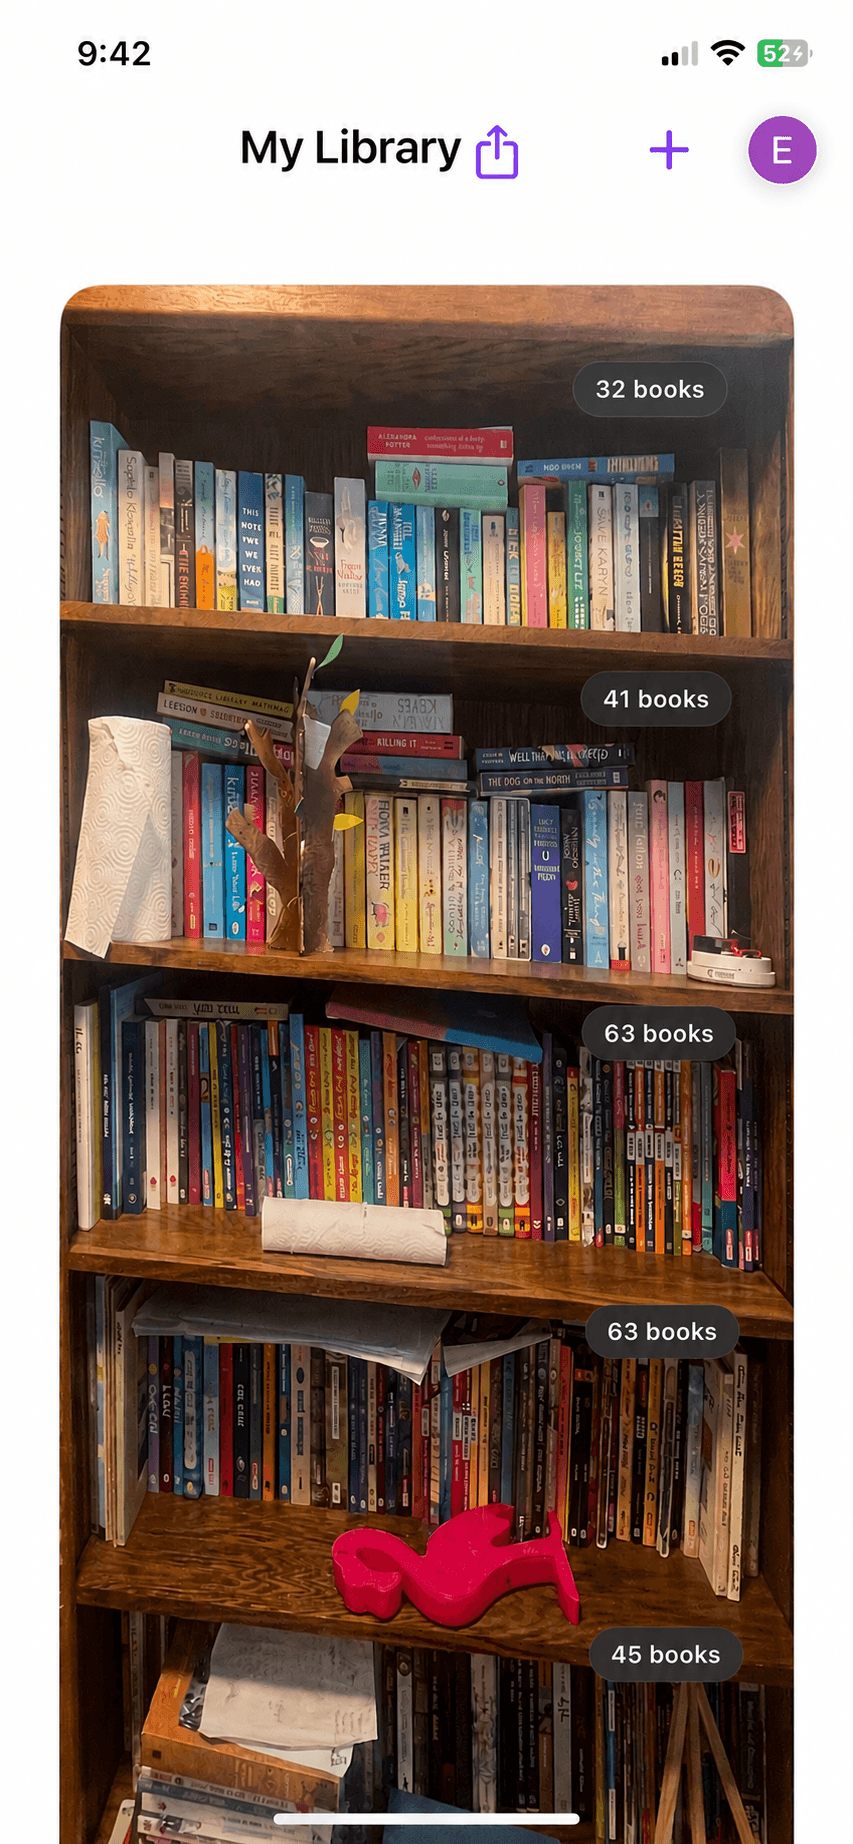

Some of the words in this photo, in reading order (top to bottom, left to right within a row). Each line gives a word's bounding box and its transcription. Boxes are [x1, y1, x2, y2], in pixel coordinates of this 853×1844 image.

[77, 40, 152, 67] 9:42
[240, 129, 303, 172] My
[315, 128, 461, 172] Library
[772, 136, 793, 164] E
[596, 379, 625, 399] 32
[634, 379, 705, 399] books
[243, 508, 259, 517] THIS
[245, 550, 258, 560] WE
[597, 547, 608, 597] KARYN
[603, 689, 629, 709] 41
[638, 689, 709, 709] books
[488, 778, 502, 787] THE
[504, 776, 521, 786] DOG
[604, 1024, 635, 1044] 63
[643, 1024, 714, 1044] books
[607, 1322, 638, 1342] 63
[646, 1322, 717, 1342] books
[612, 1645, 642, 1665] 45
[650, 1644, 721, 1664] books
